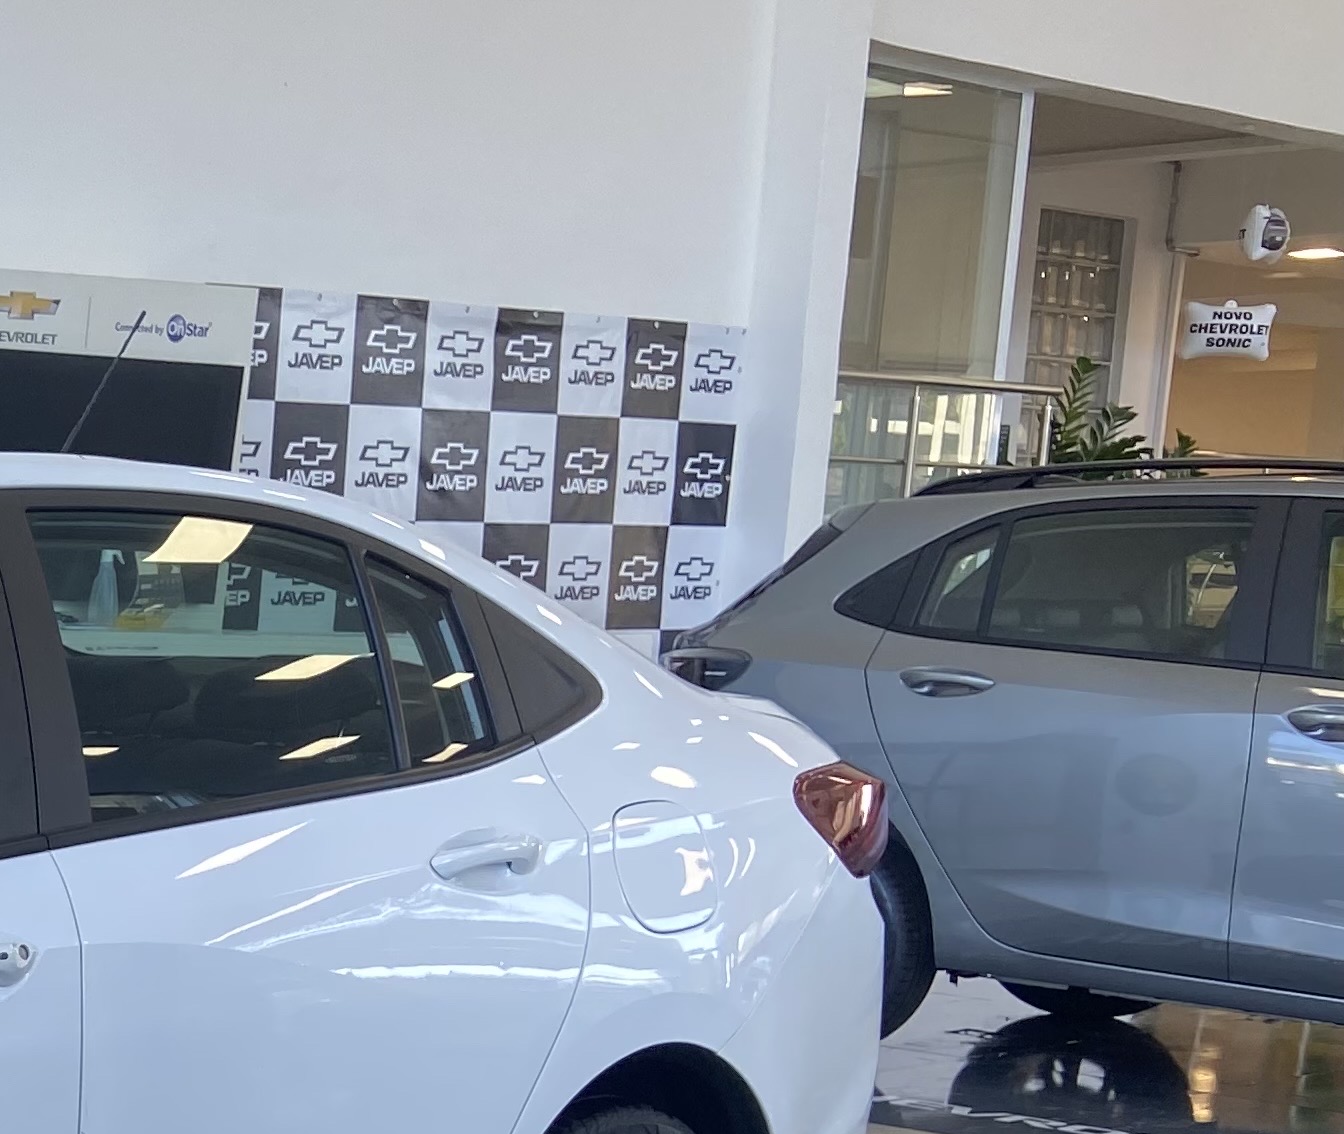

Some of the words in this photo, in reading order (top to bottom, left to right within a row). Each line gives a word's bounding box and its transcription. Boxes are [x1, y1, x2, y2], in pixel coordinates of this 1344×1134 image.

[1212, 311, 1253, 320] NOVO
[1189, 323, 1269, 335] CHEVROLET
[1205, 337, 1252, 348] SONIC
[288, 352, 343, 370] JAVEP
[362, 357, 415, 375] JAVEP
[433, 362, 484, 379] JAVEP
[501, 365, 551, 384] JAVEP
[568, 369, 615, 386] JAVEP
[630, 372, 676, 391] JAVEP
[689, 377, 733, 393] JAVEP
[355, 472, 408, 488] JAVEP
[426, 474, 478, 491] JAVEP
[495, 476, 544, 492] JAVEP
[560, 476, 609, 495] JAVEP
[623, 480, 667, 496] JAVEP
[680, 482, 723, 499] JAVEP
[270, 590, 325, 606] JAVEP
[554, 585, 600, 600] JAVEP
[614, 584, 657, 601] JAVEP
[670, 585, 711, 600] JAVEP
